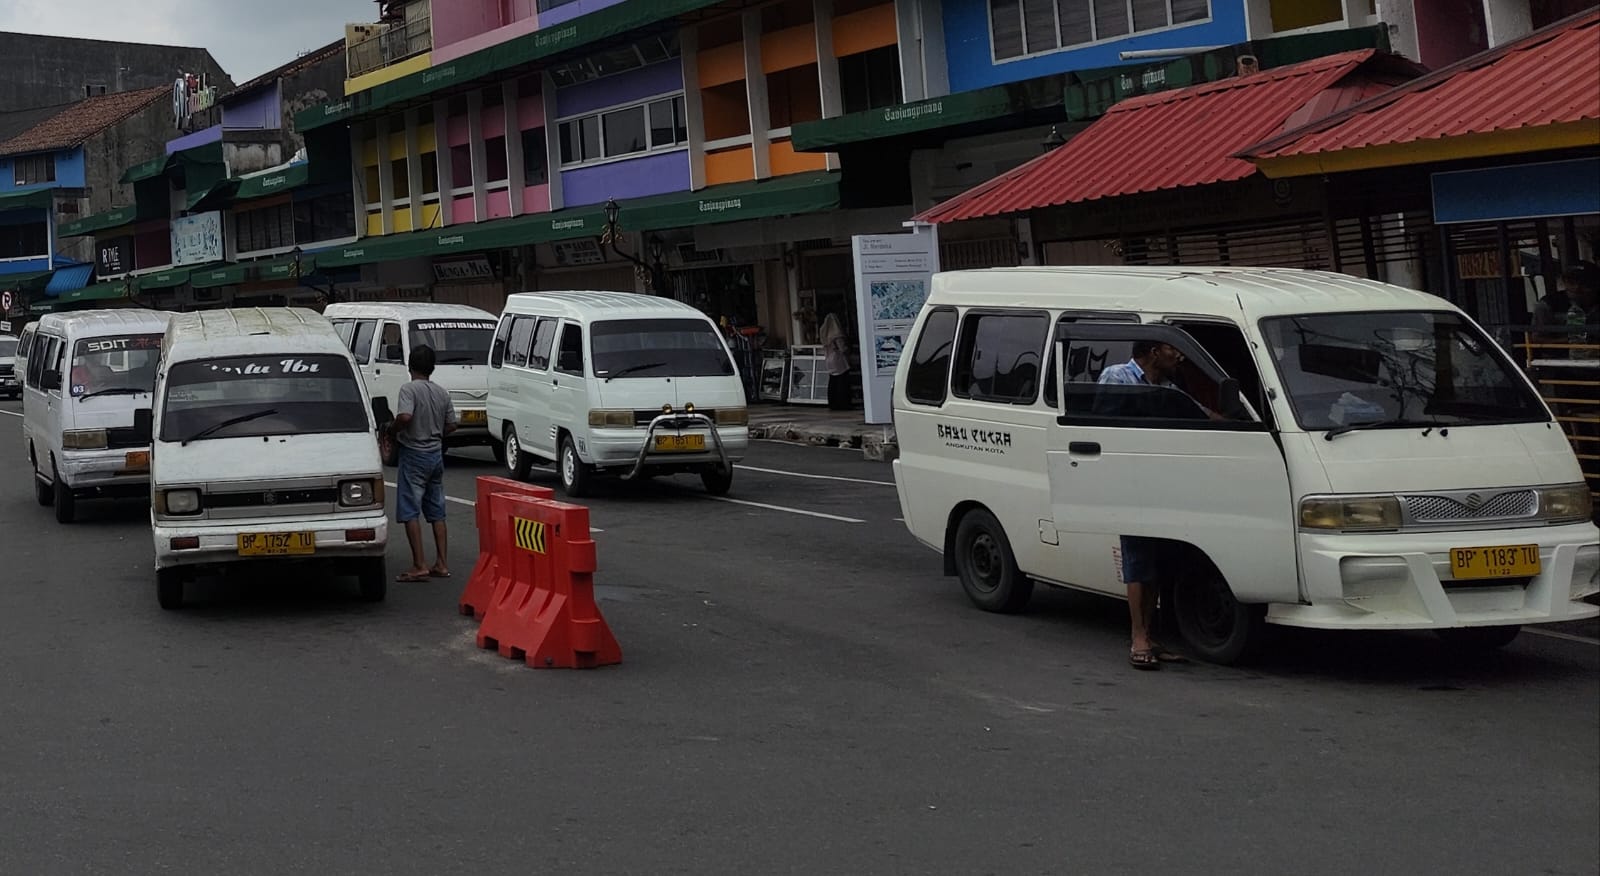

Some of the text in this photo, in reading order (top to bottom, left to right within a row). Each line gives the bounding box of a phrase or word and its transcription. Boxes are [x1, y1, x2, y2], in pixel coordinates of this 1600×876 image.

[884, 101, 943, 121] Tanjungpinang
[87, 339, 130, 352] SDIT
[73, 385, 85, 394] 03
[937, 424, 1011, 447] BAYU PUTRA
[945, 442, 1005, 455] ANGKUTAN KOTA
[242, 532, 313, 549] BP 1752 TU
[1456, 547, 1537, 568] BP 1183 TU
